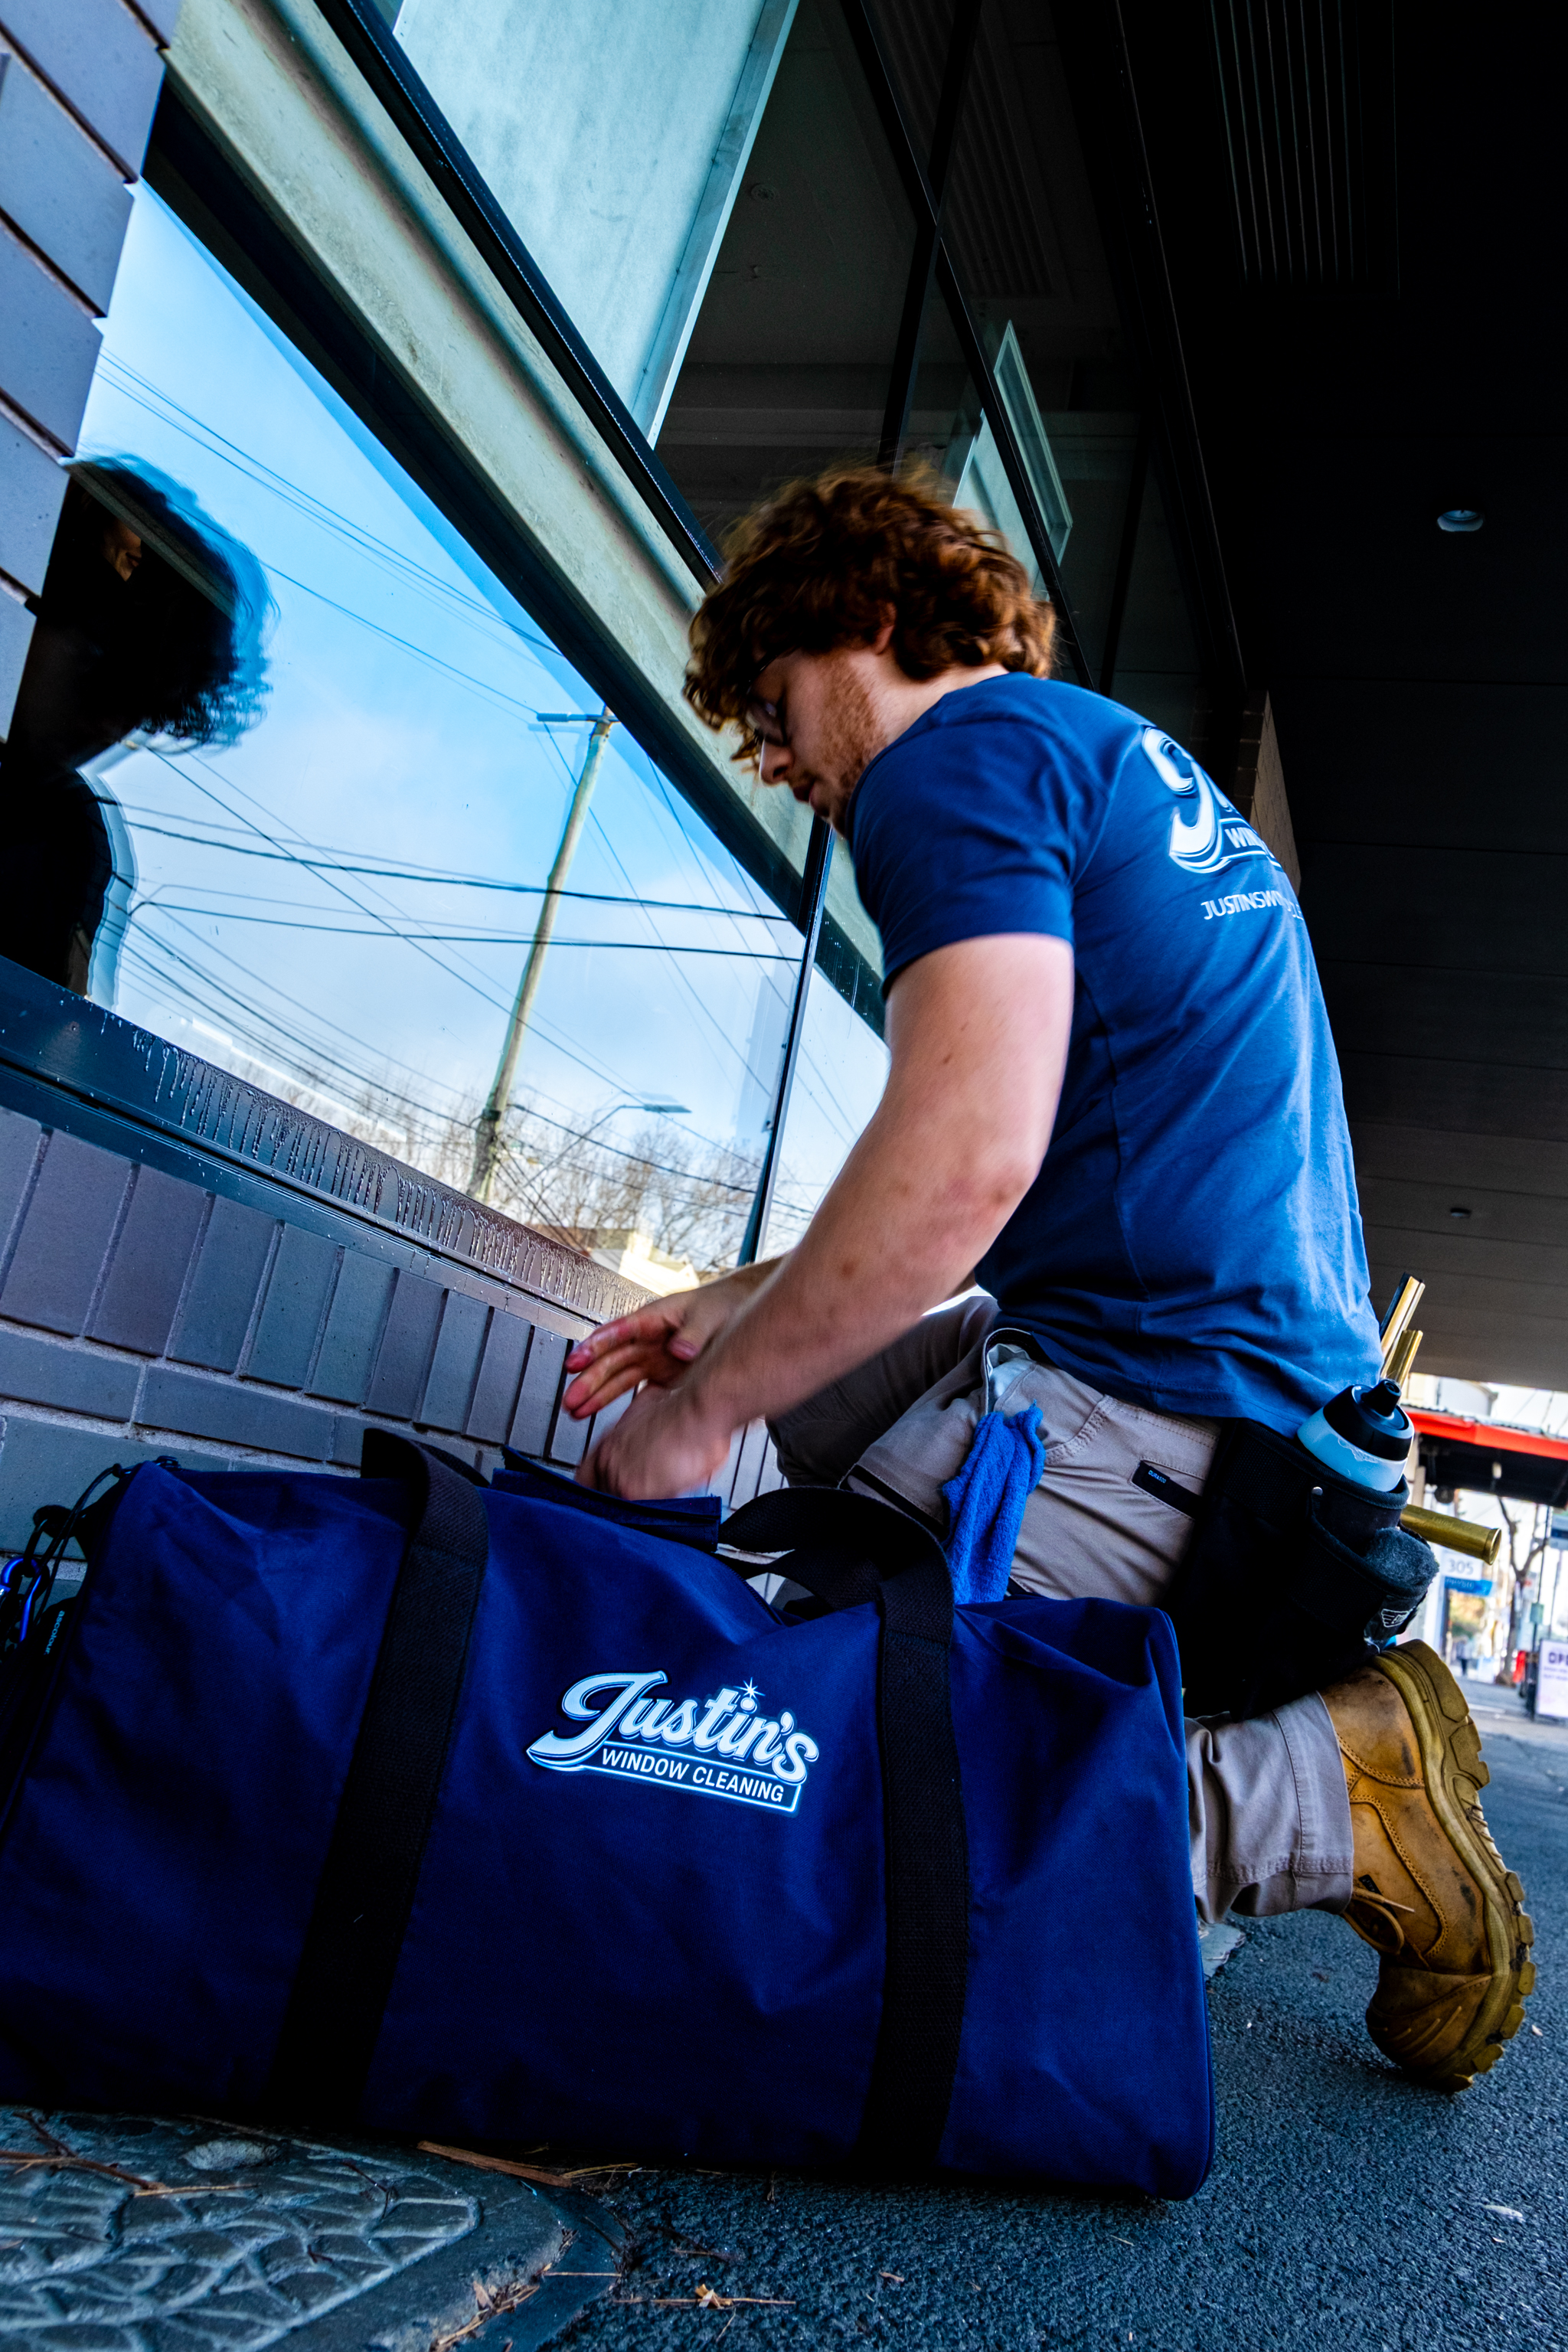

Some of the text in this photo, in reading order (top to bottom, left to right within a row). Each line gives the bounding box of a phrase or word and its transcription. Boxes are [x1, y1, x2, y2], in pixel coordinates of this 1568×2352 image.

[1448, 1558, 1474, 1576] 305
[528, 1671, 819, 1785] Justin's
[602, 1749, 784, 1803] WINDOW CLEANING
